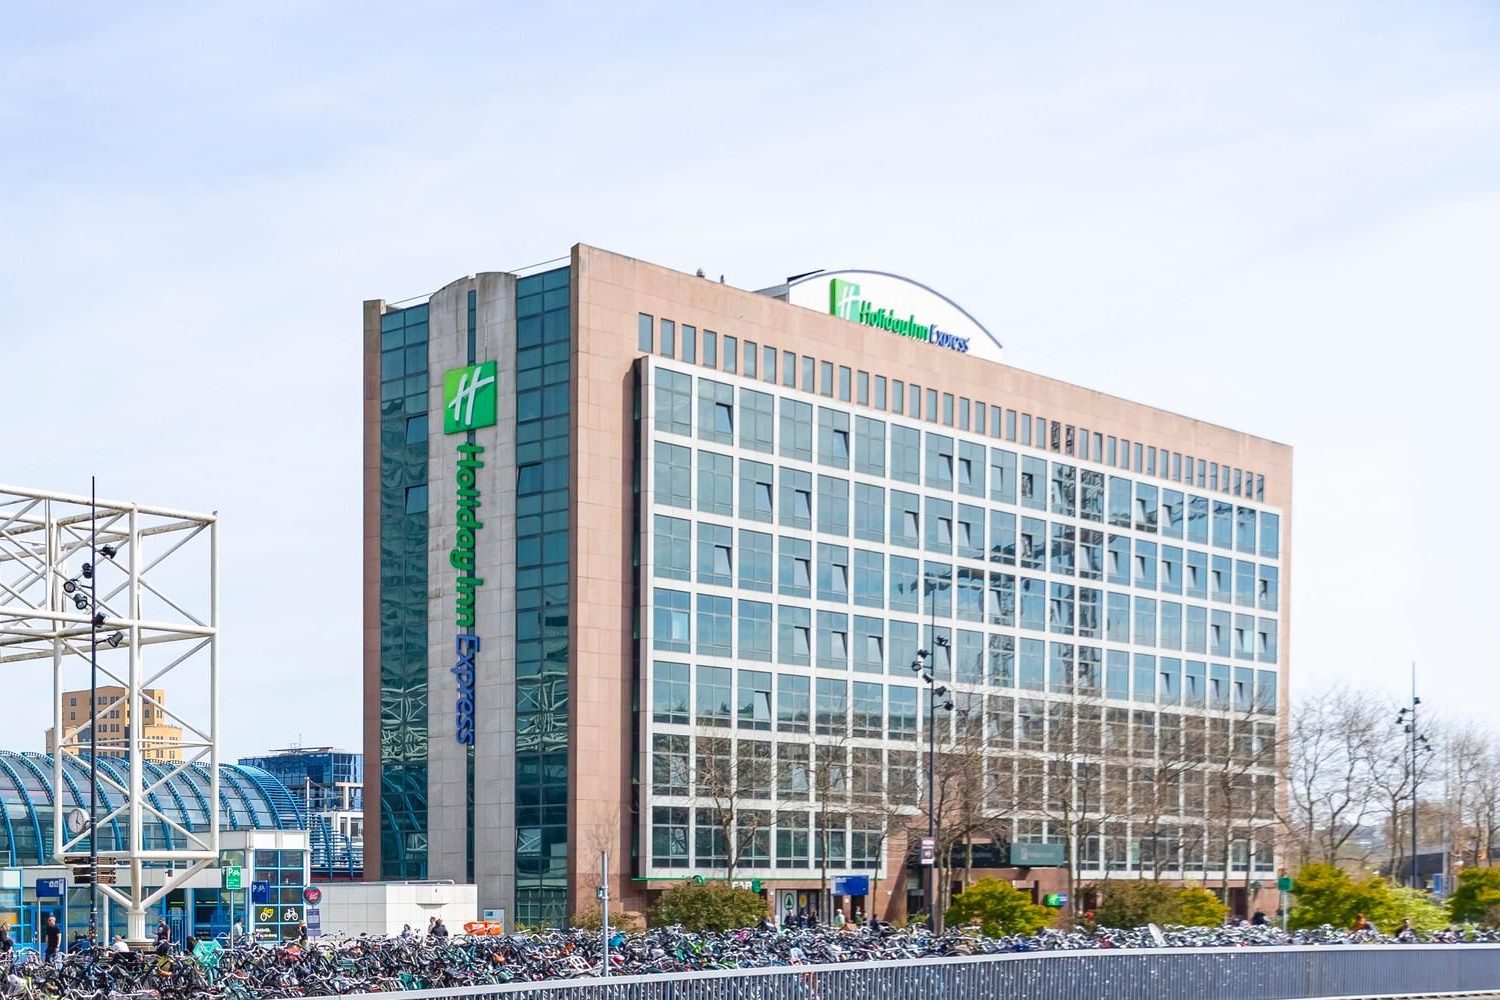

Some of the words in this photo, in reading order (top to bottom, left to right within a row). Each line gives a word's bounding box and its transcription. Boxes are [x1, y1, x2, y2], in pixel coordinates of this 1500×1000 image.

[859, 299, 907, 336] Holiday
[908, 314, 929, 342] Inn
[929, 323, 970, 353] Express
[450, 441, 485, 570] Holiday
[456, 576, 485, 628] Inn
[450, 633, 481, 745] Express
